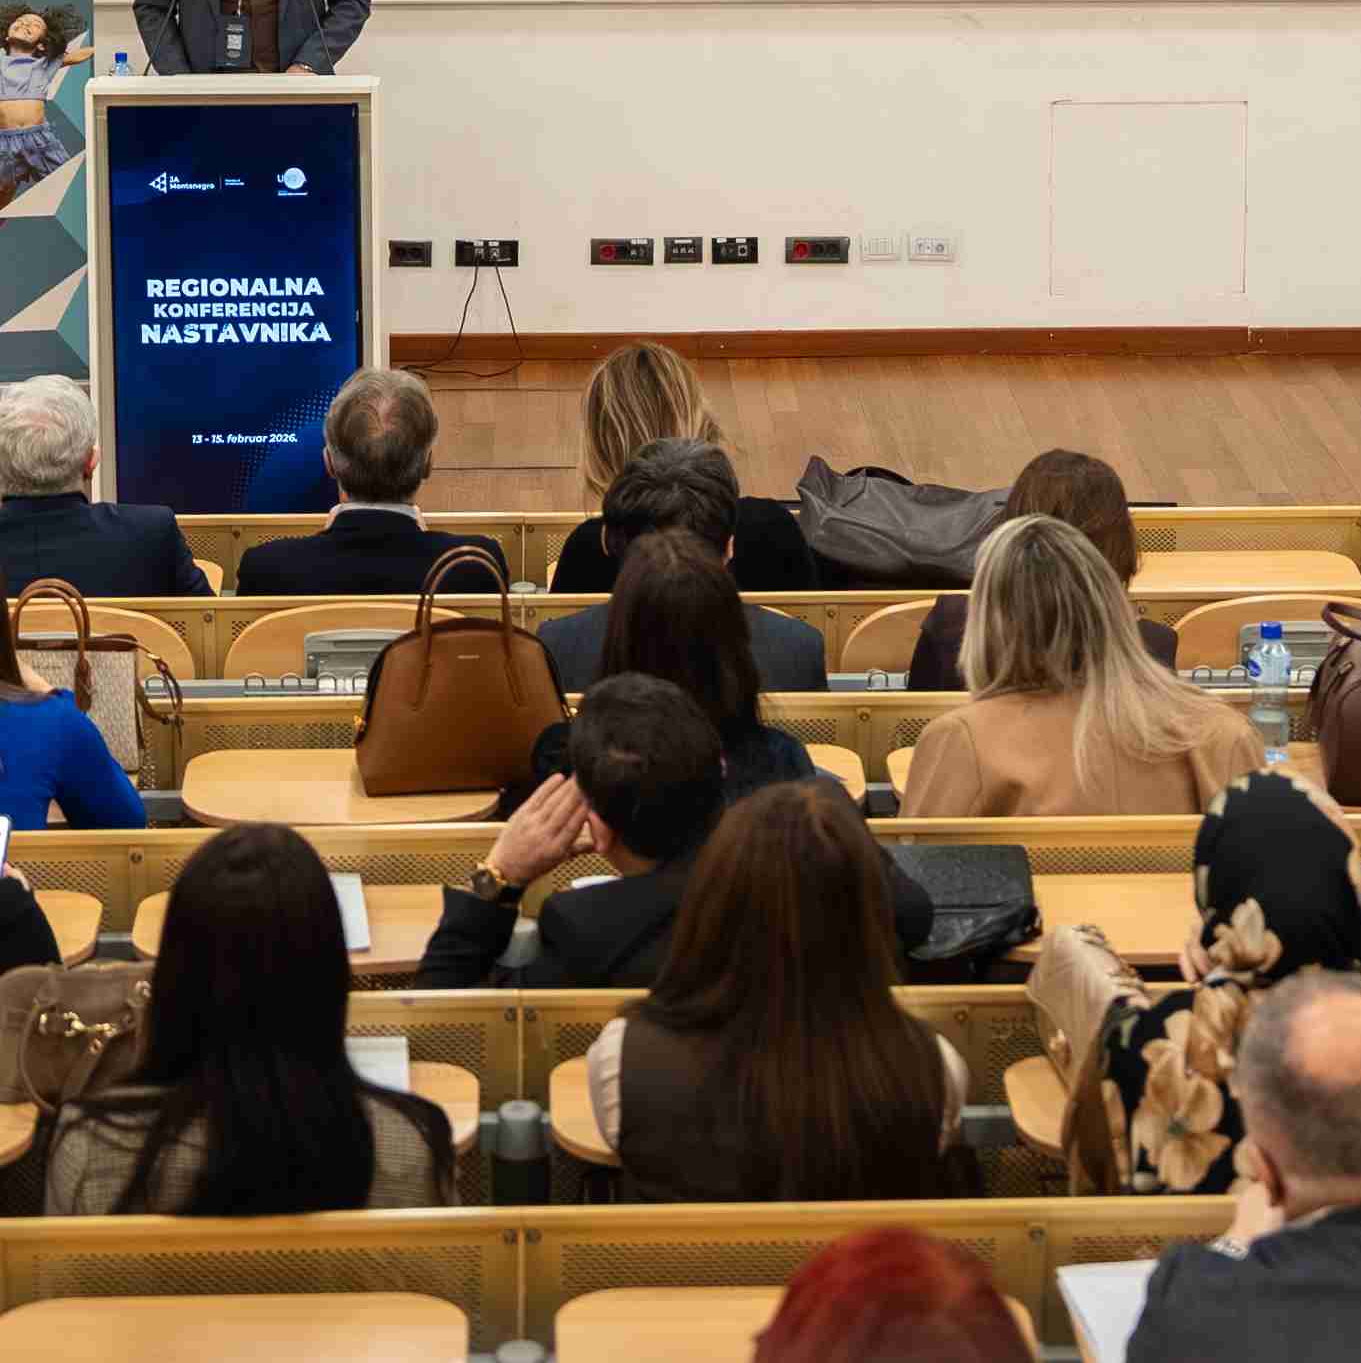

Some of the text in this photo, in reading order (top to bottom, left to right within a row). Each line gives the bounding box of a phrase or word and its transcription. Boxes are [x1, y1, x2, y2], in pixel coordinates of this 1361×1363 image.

[146, 277, 325, 298] REGIONALNA
[153, 301, 315, 318] KONFERENCIJA
[140, 321, 332, 344] NASTAVNIKA
[226, 433, 268, 444] februar
[268, 433, 298, 443] 2026.
